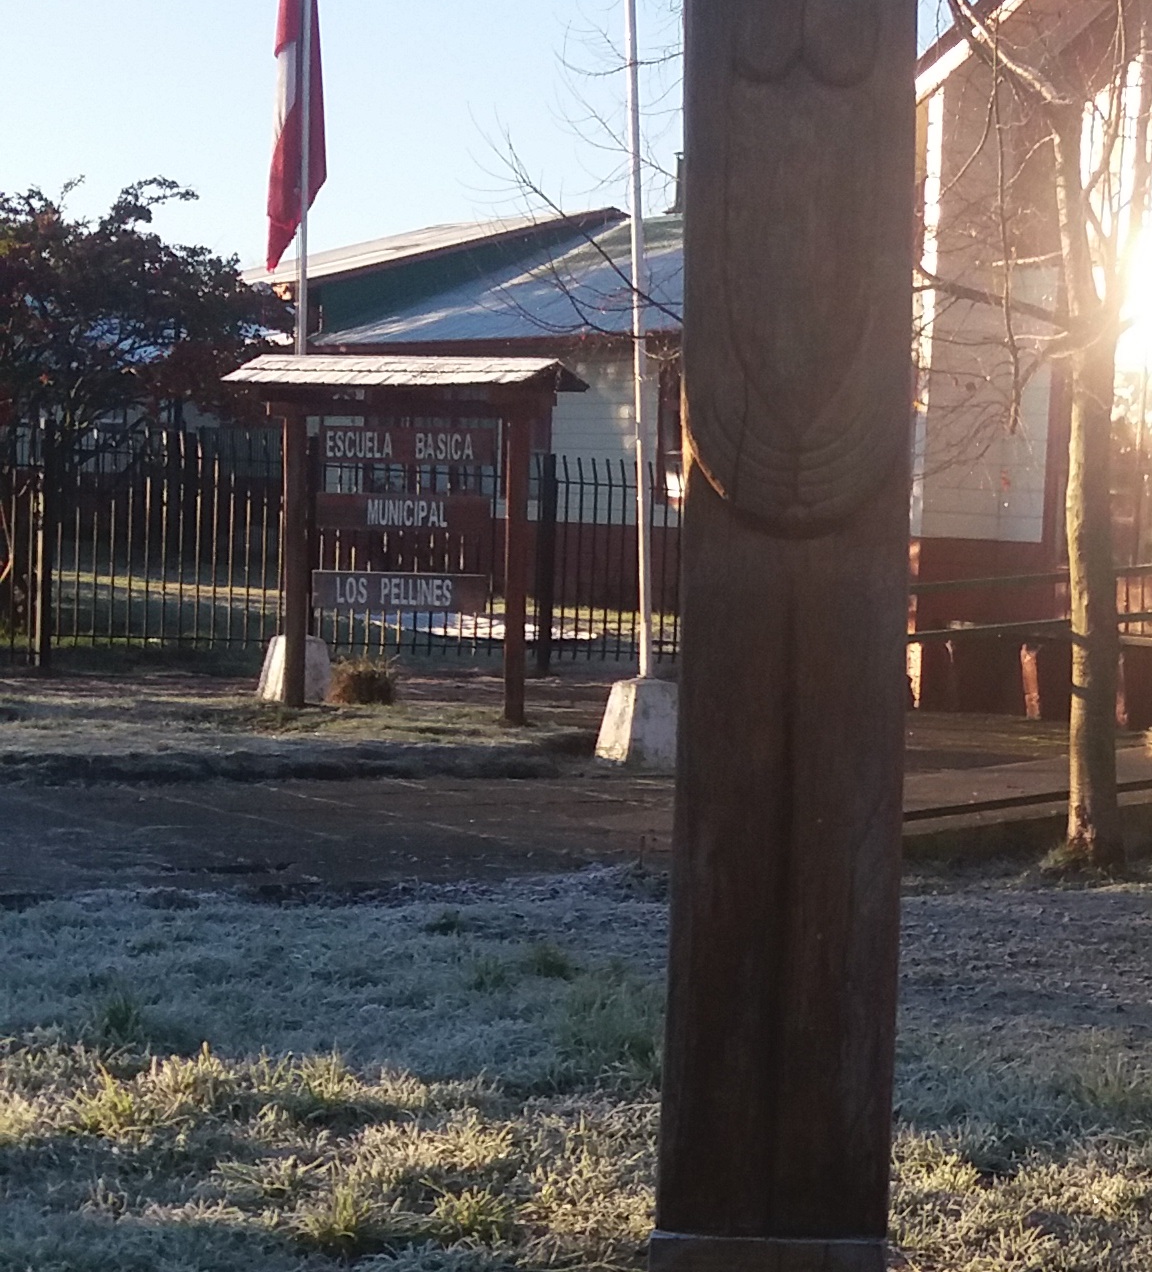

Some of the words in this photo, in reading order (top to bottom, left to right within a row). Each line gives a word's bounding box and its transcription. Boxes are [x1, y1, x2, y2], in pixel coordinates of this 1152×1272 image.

[326, 431, 392, 458] ESCUELA
[415, 433, 473, 460] BASICA
[367, 499, 447, 527] MUNICIPAL
[336, 577, 367, 604] LOS
[381, 578, 452, 606] PELLINES
